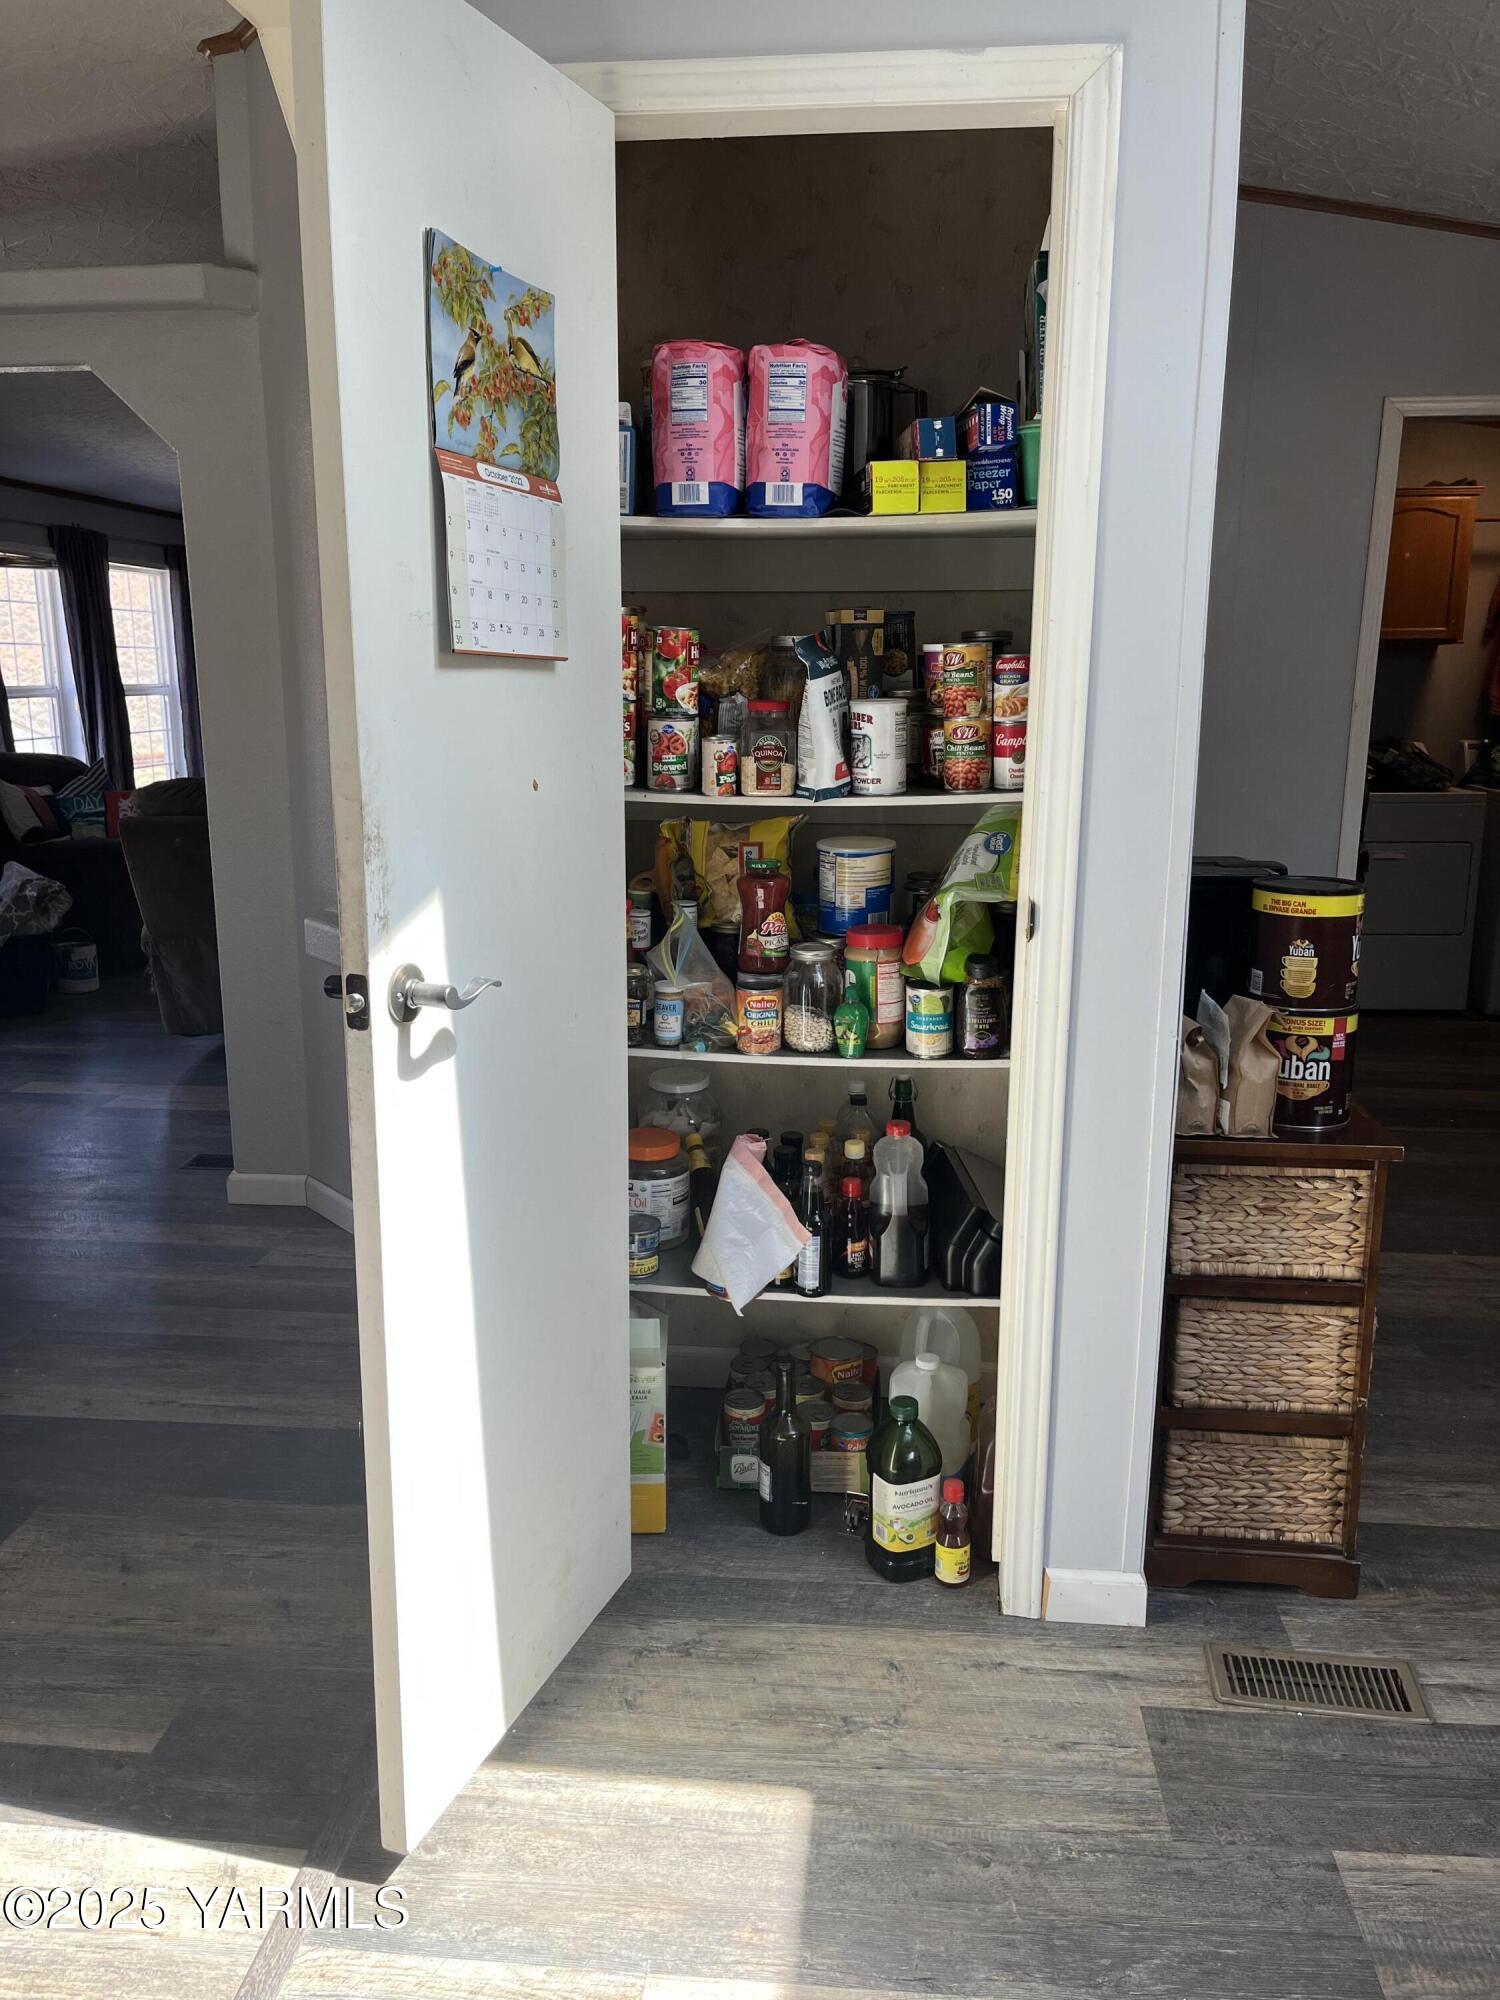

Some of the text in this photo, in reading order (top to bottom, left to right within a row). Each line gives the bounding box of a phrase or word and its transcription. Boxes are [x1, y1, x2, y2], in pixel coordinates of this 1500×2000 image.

[999, 404, 1007, 426] Wrap
[1006, 406, 1015, 441] Reynolds
[968, 468, 1011, 479] Freezer
[968, 479, 1001, 492] Paper
[992, 487, 1013, 501] 150
[995, 659, 1026, 670] Campbell's
[754, 749, 784, 758] QUINOA
[946, 744, 963, 752] Chili
[652, 761, 688, 772] Stewed
[854, 777, 882, 785] POWDER
[73, 796, 102, 812] DAY
[1281, 899, 1292, 907] BIG
[1293, 900, 1307, 908] CAN
[1290, 907, 1317, 915] GRANDE
[1288, 945, 1315, 957] Yuban
[749, 1000, 776, 1009] Nalley
[746, 1009, 777, 1019] ORIGINAL
[750, 1019, 775, 1027] CHILI
[1306, 1019, 1326, 1027] SIZE!
[1278, 1054, 1331, 1080] uban
[633, 1197, 647, 1209] Oil
[892, 1496, 934, 1511] AVOCADO OIL
